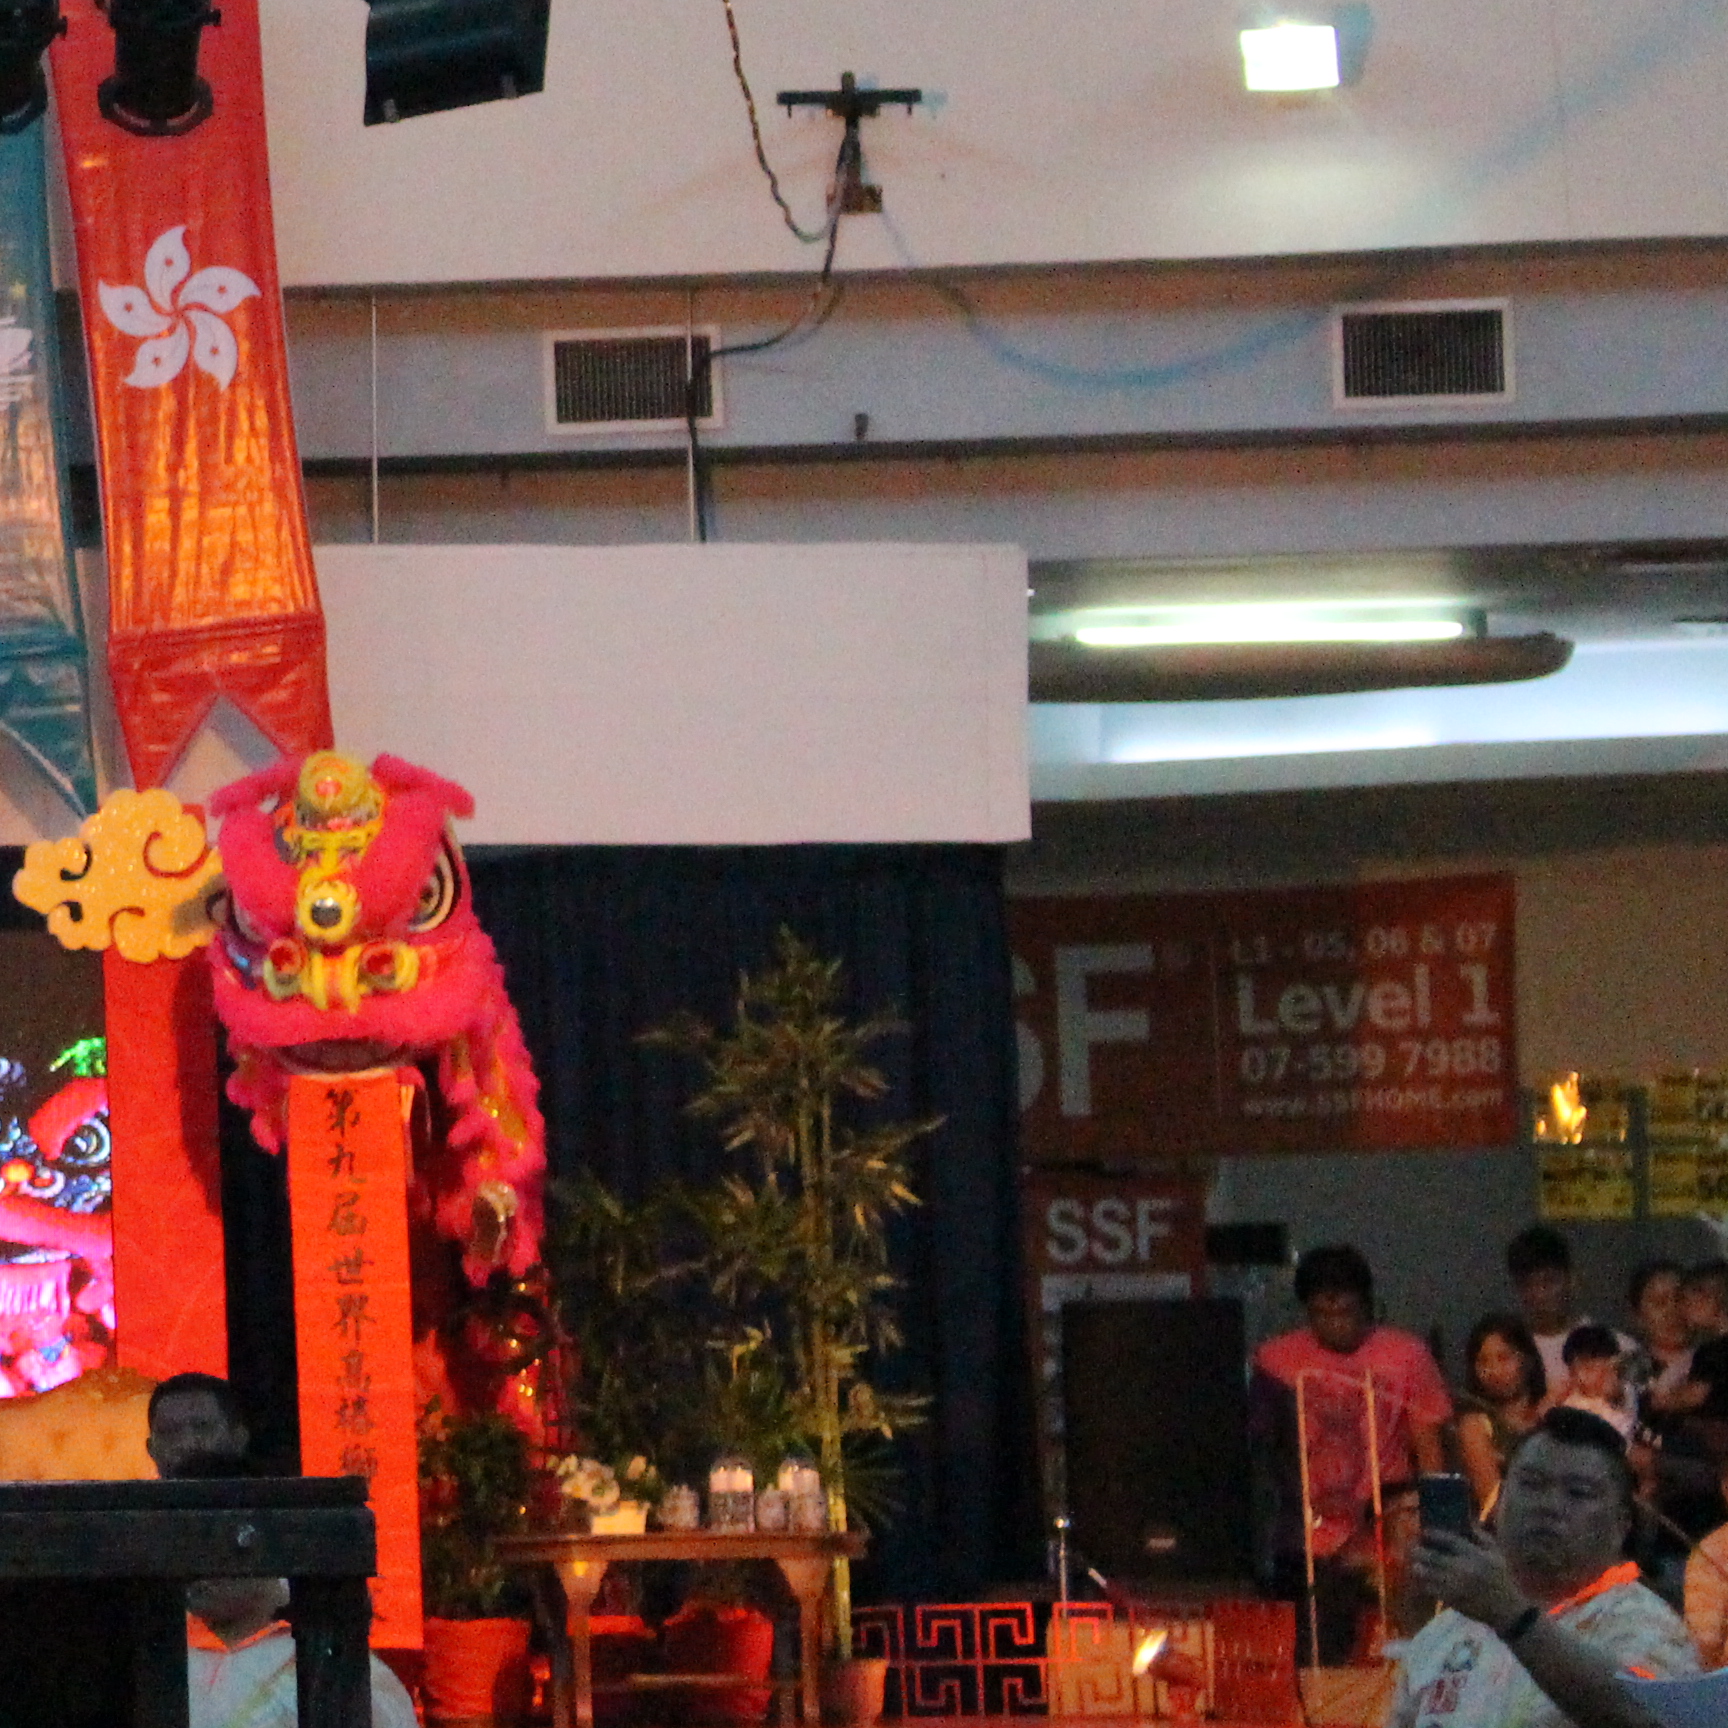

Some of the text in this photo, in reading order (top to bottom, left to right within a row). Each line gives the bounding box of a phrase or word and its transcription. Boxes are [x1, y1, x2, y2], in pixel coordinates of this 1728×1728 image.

[1235, 962, 1501, 1036] Level 1
[1045, 1197, 1176, 1265] SSF
